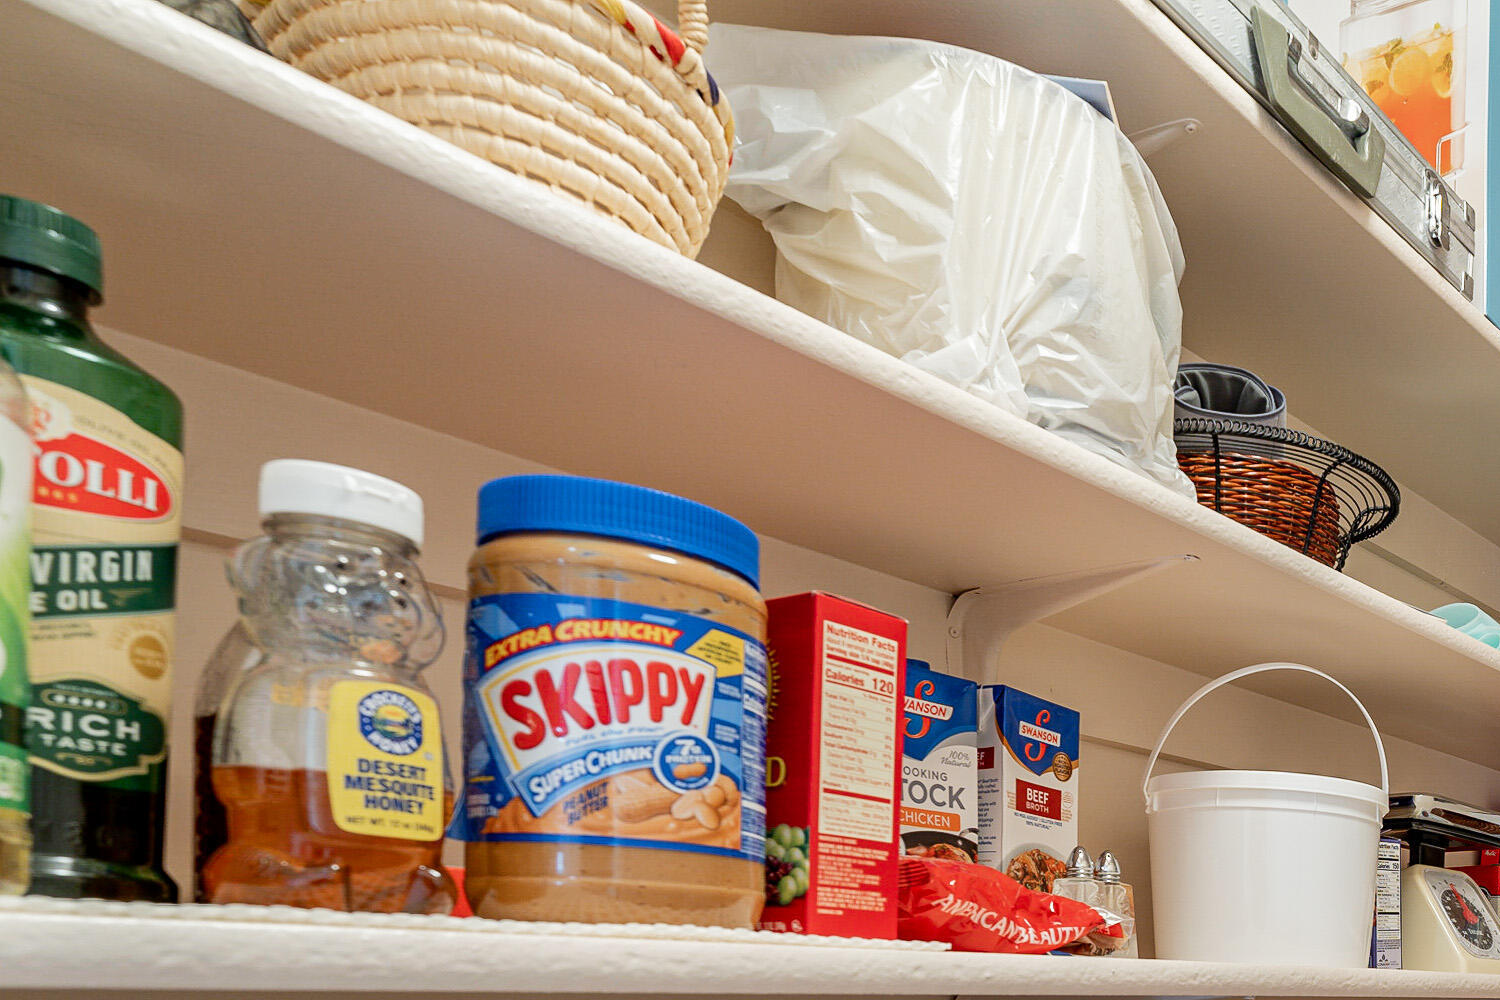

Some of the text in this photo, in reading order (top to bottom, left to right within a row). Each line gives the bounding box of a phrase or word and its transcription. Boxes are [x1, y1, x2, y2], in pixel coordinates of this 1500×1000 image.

[34, 447, 158, 512] OLLI
[30, 551, 153, 585] VIRGIN
[56, 589, 107, 611] OIL
[484, 624, 553, 669] EXTRA
[554, 618, 683, 648] CRUNCHY
[827, 624, 870, 644] Nutrition
[871, 637, 896, 653] Facts
[825, 668, 895, 695] Calories 120
[501, 658, 706, 751] SKIPPY
[904, 697, 948, 720] WANSON
[27, 706, 141, 742] RICH
[1021, 724, 1059, 744] SWANSON
[38, 733, 127, 757] TASTE
[358, 758, 426, 781] DESERT
[903, 765, 949, 782] OOKING
[940, 757, 971, 769] Natural
[344, 775, 435, 801] MESQUITE
[562, 780, 610, 814] PEANUT
[901, 778, 966, 810] TOCK
[1026, 786, 1050, 804] BEEF
[364, 794, 424, 815] HONEY
[567, 796, 610, 826] BUTTER
[1025, 800, 1050, 814] BROTH
